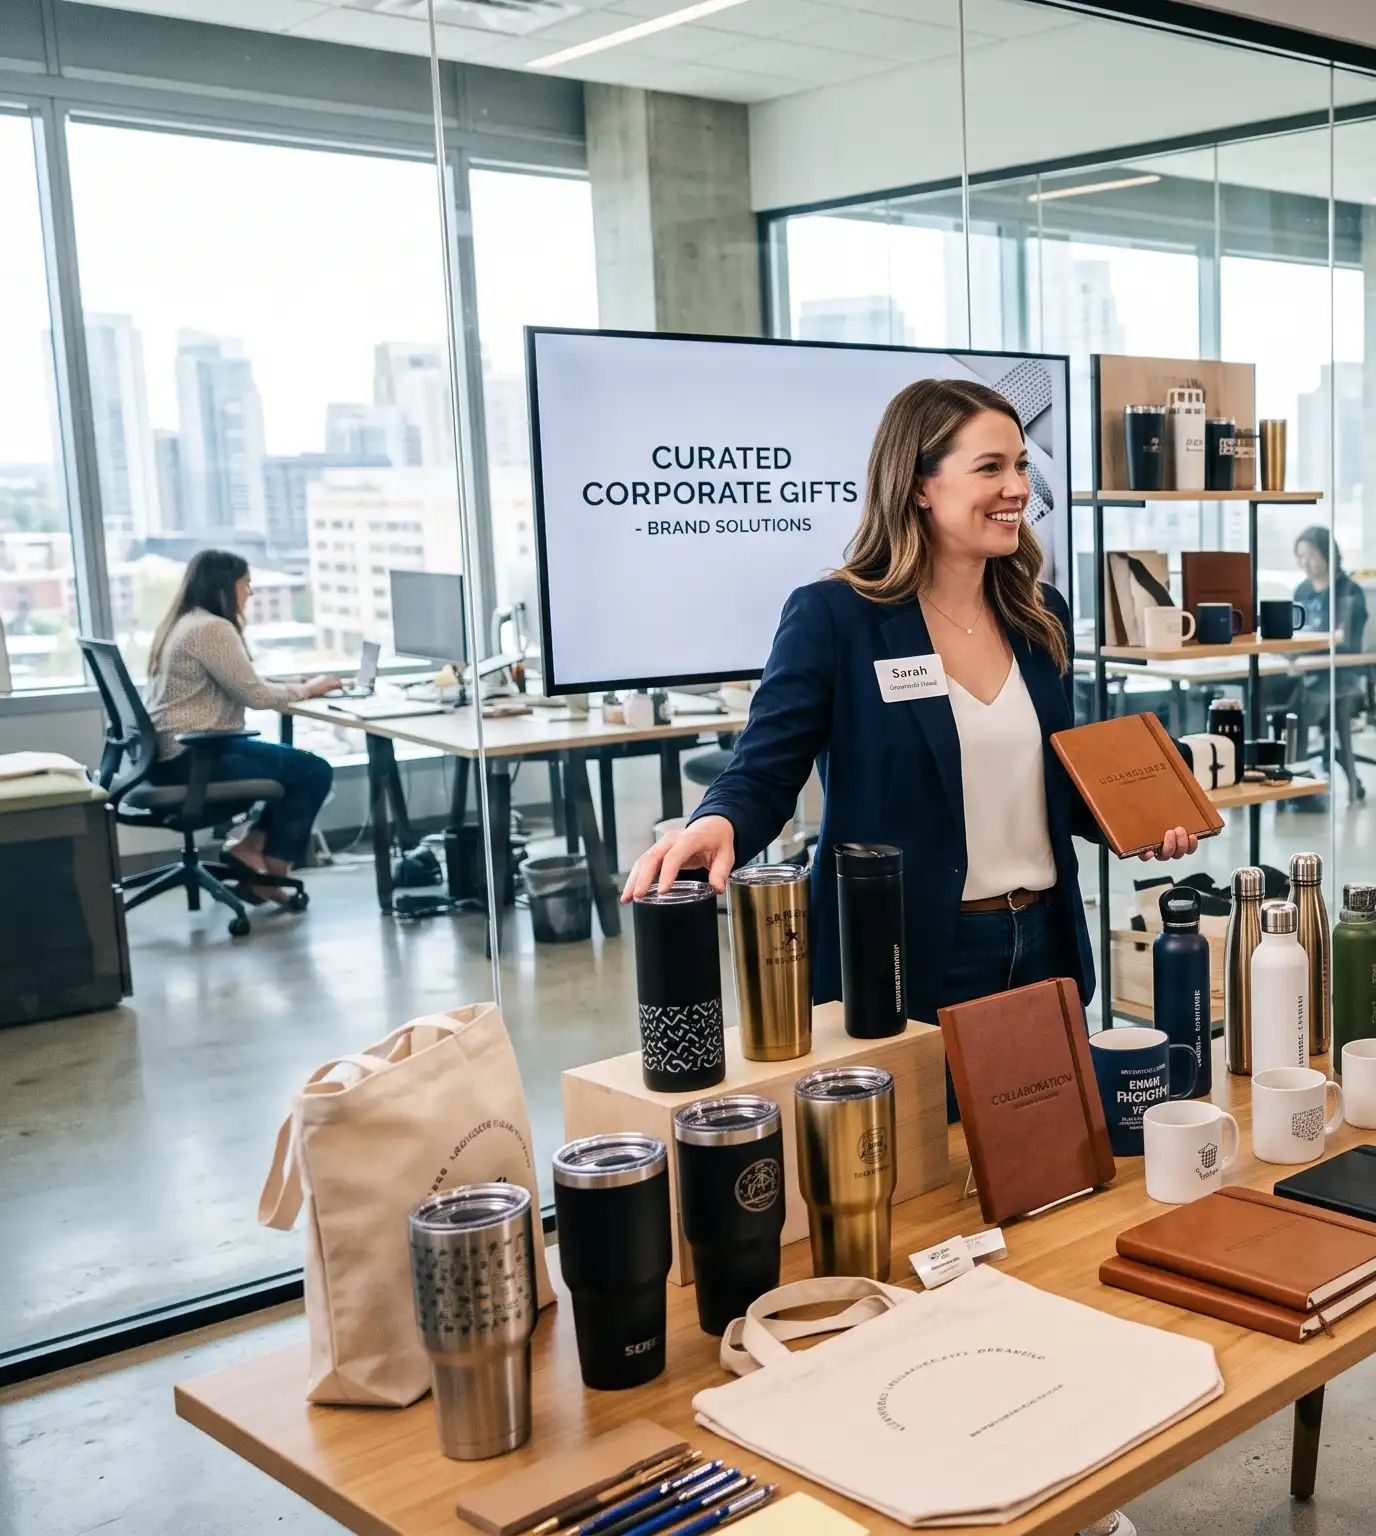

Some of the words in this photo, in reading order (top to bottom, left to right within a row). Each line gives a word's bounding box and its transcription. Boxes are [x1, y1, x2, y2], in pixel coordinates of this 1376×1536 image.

[652, 445, 792, 470] CURATED
[582, 481, 772, 506] CORPORATE
[779, 481, 858, 503] GIFTS
[648, 520, 711, 535] BRAND
[715, 518, 812, 534] SOLUTIONS
[891, 665, 928, 679] Sarah
